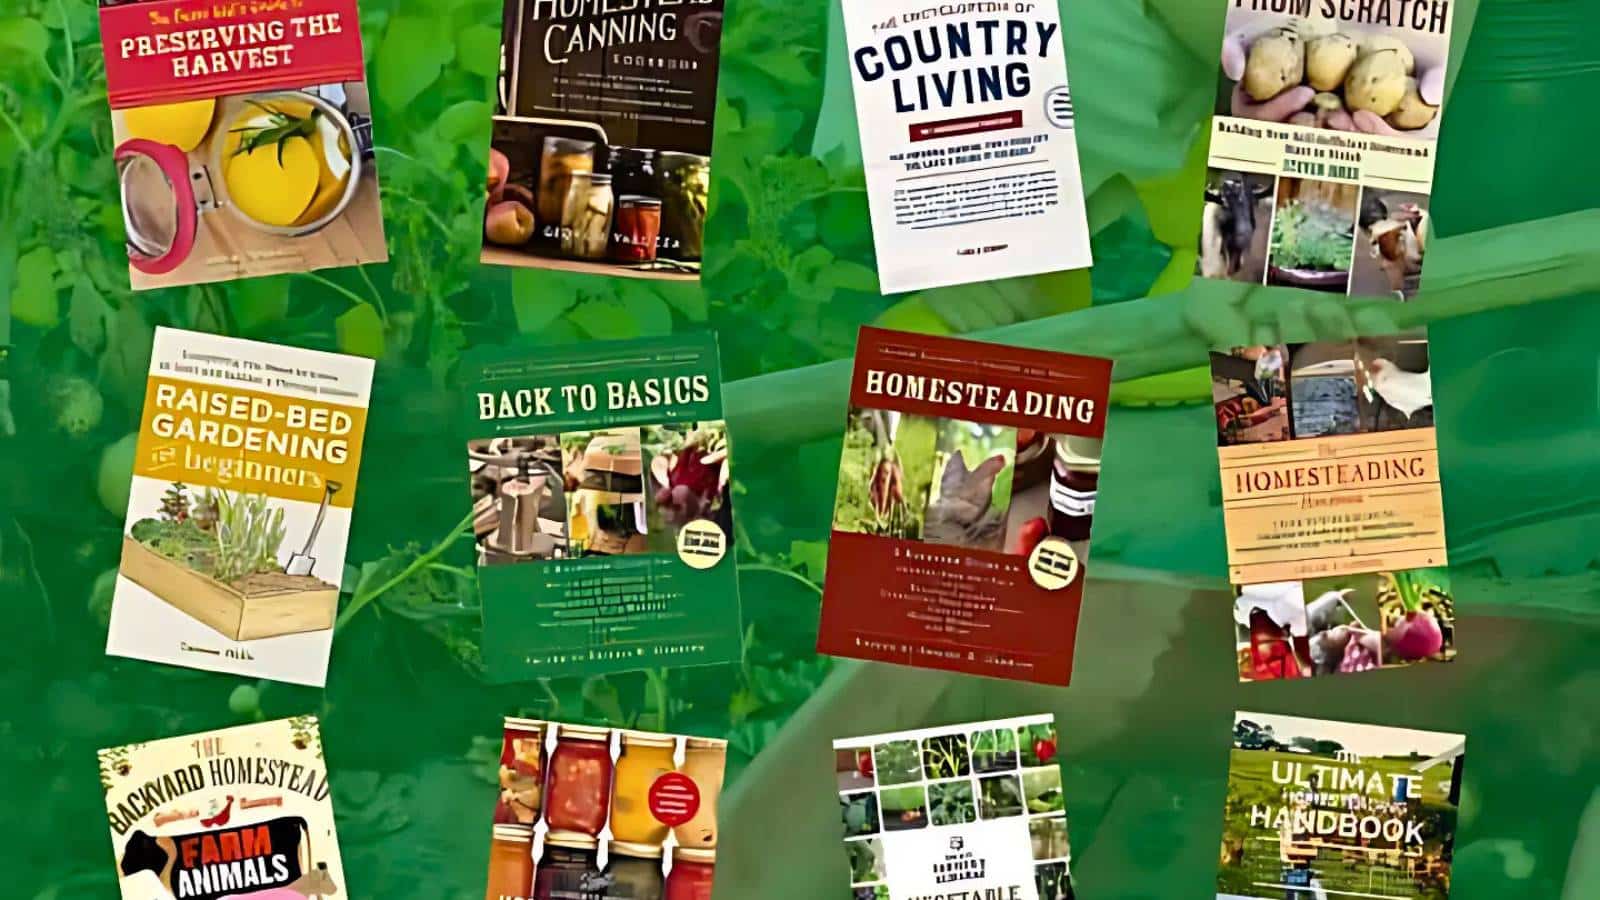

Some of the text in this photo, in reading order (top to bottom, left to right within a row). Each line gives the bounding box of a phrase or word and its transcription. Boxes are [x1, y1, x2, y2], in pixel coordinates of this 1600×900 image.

[121, 13, 342, 58] PRESERVING THE
[544, 13, 676, 64] CANNING
[854, 20, 1057, 82] COUNTRY
[172, 44, 294, 77] HARVEST
[892, 62, 1031, 113] LIVING
[156, 384, 352, 435] RAISED-BED
[477, 375, 710, 420] BACK TO BASICS
[866, 369, 1095, 424] HOMESTEADING
[152, 415, 348, 464] GARDENING
[1236, 457, 1425, 493] HOMESTEADING
[108, 764, 205, 835] BACKYARD
[209, 757, 330, 801] HOMESTEAD
[1272, 760, 1423, 798] ULTIMATE
[1250, 804, 1424, 844] HANDBOOK
[178, 853, 289, 898] ANIMALS
